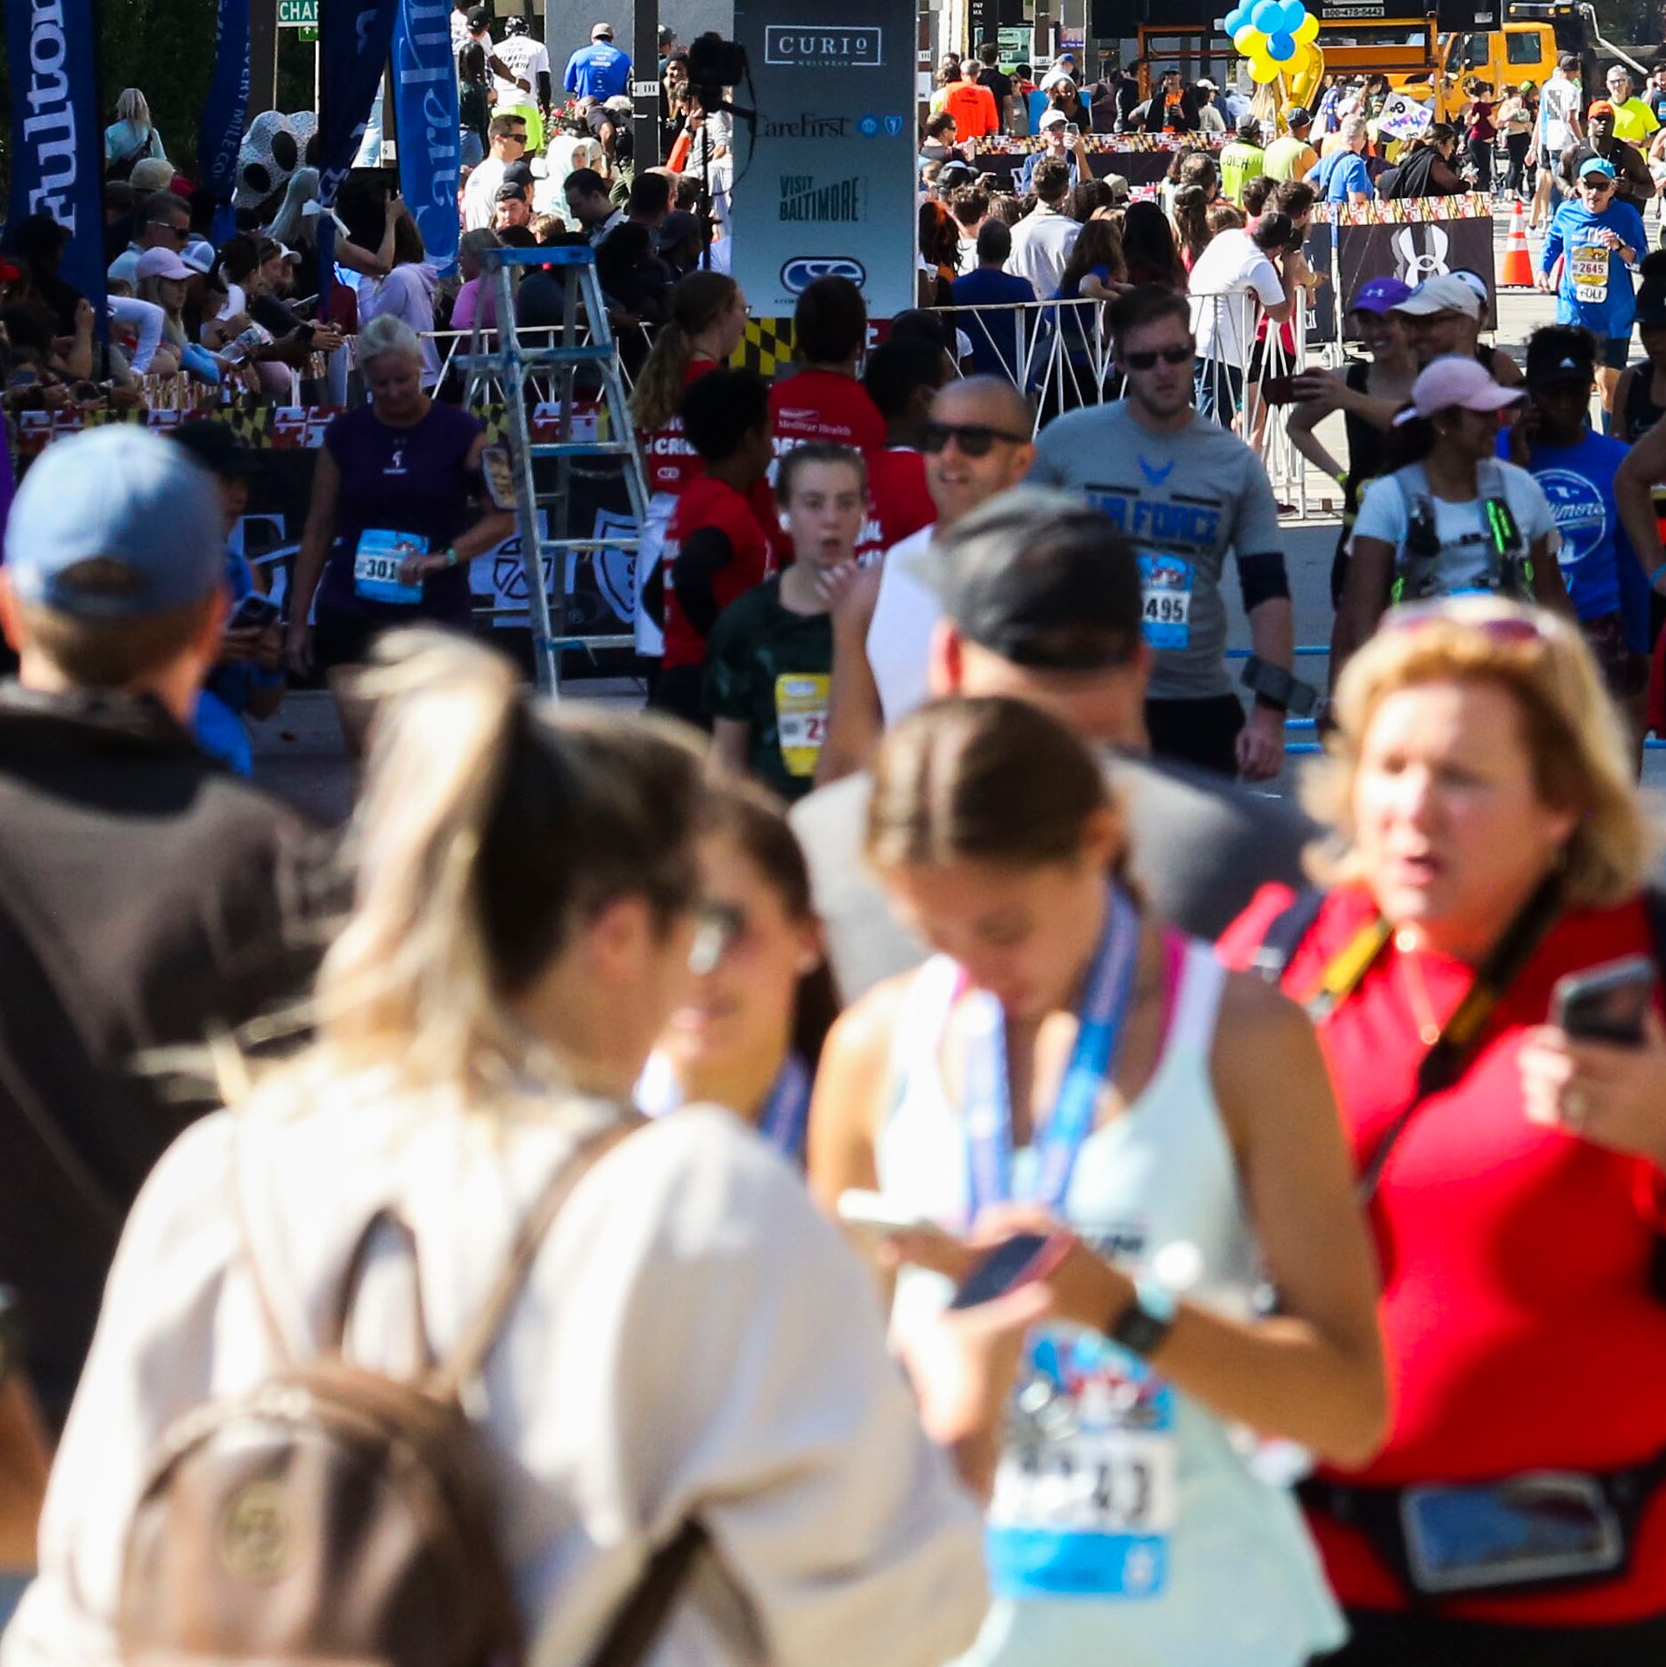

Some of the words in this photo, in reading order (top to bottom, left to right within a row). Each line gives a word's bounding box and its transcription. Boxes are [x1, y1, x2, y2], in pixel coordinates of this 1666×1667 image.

[779, 174, 814, 200] VISIT
[779, 176, 860, 223] BALTIMORE
[1579, 262, 1605, 275] 2645
[778, 419, 819, 434] MedStar
[1131, 500, 1223, 547] FORCE
